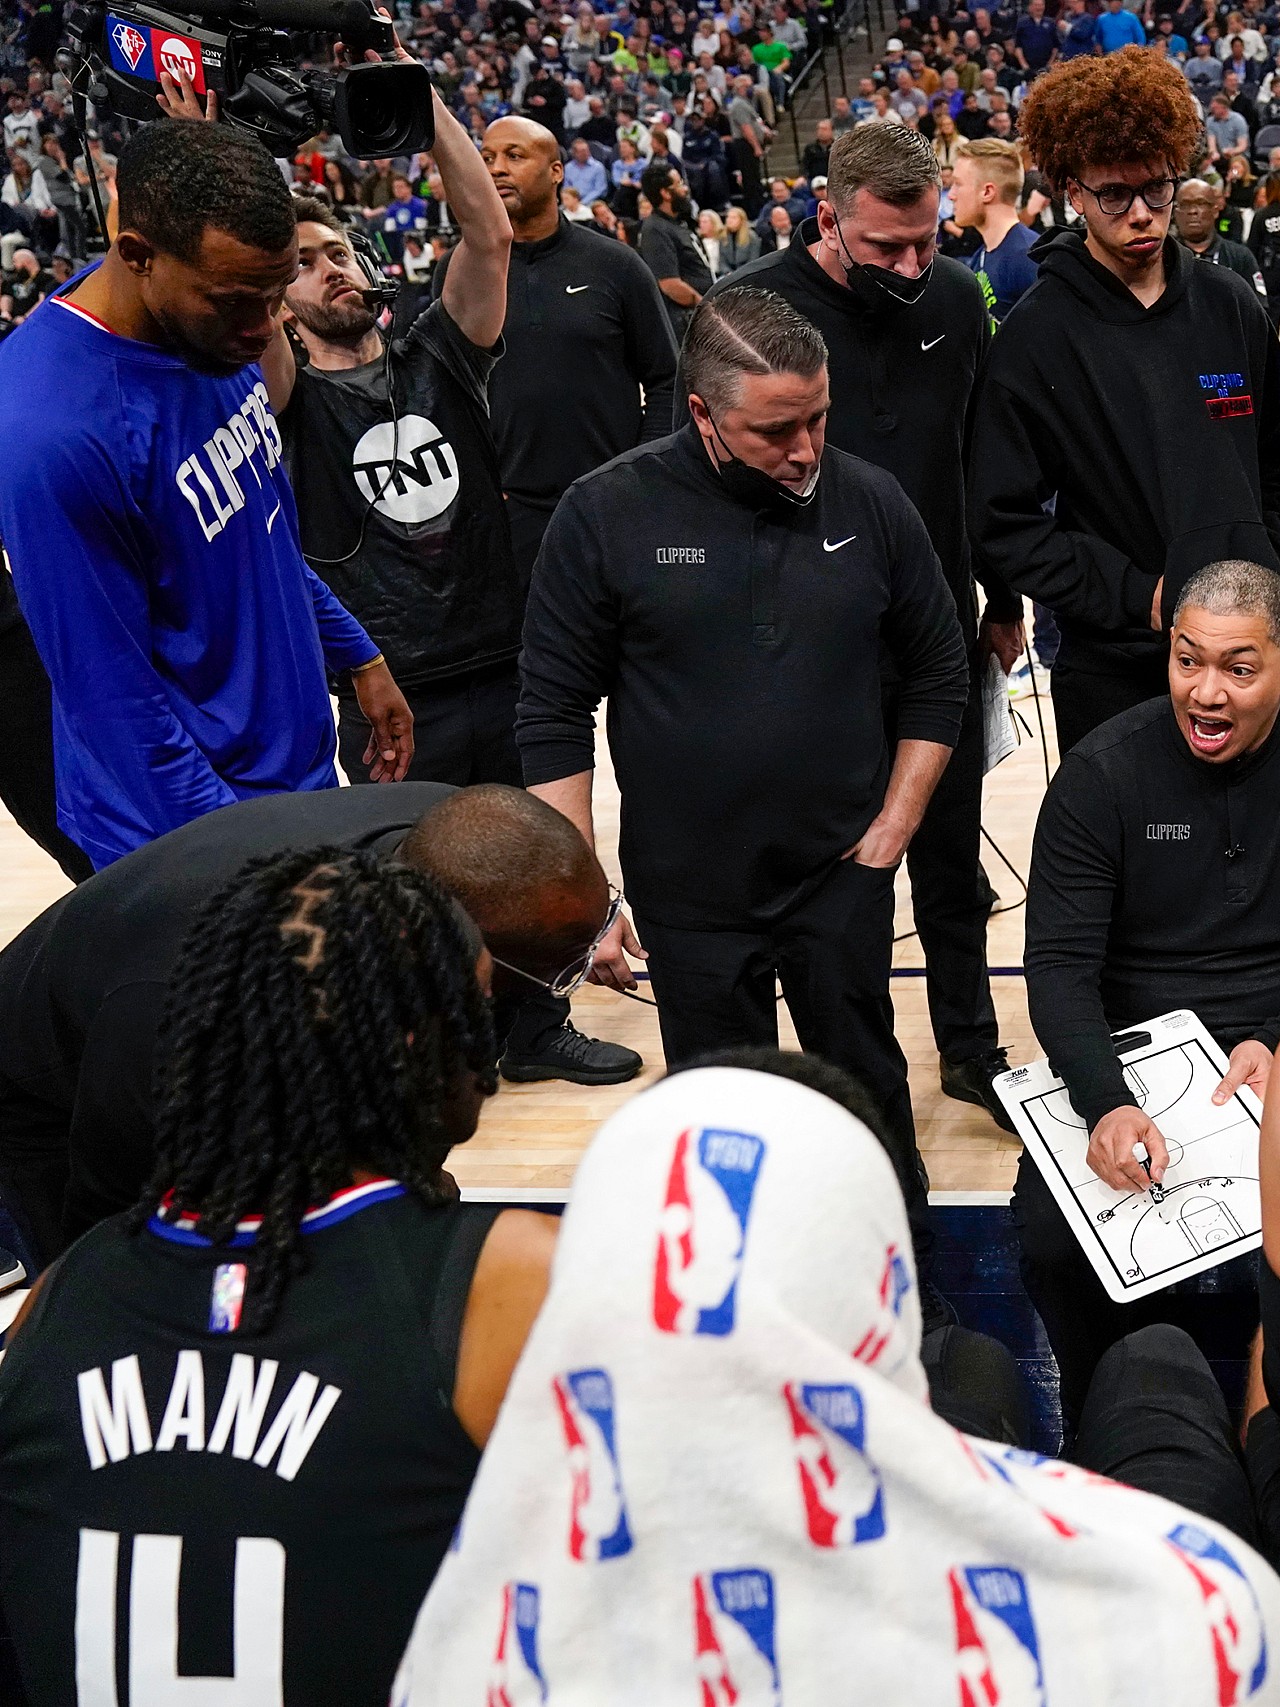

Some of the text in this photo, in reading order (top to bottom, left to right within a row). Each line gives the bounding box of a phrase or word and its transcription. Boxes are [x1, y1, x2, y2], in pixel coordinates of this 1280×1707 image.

[161, 50, 194, 76] TNT
[201, 48, 222, 59] SONY
[353, 436, 453, 501] TNT
[656, 547, 705, 564] CLIPPERS
[1147, 824, 1190, 840] CLIPPERS
[77, 1349, 342, 1482] MANN
[75, 1527, 287, 1707] 14
